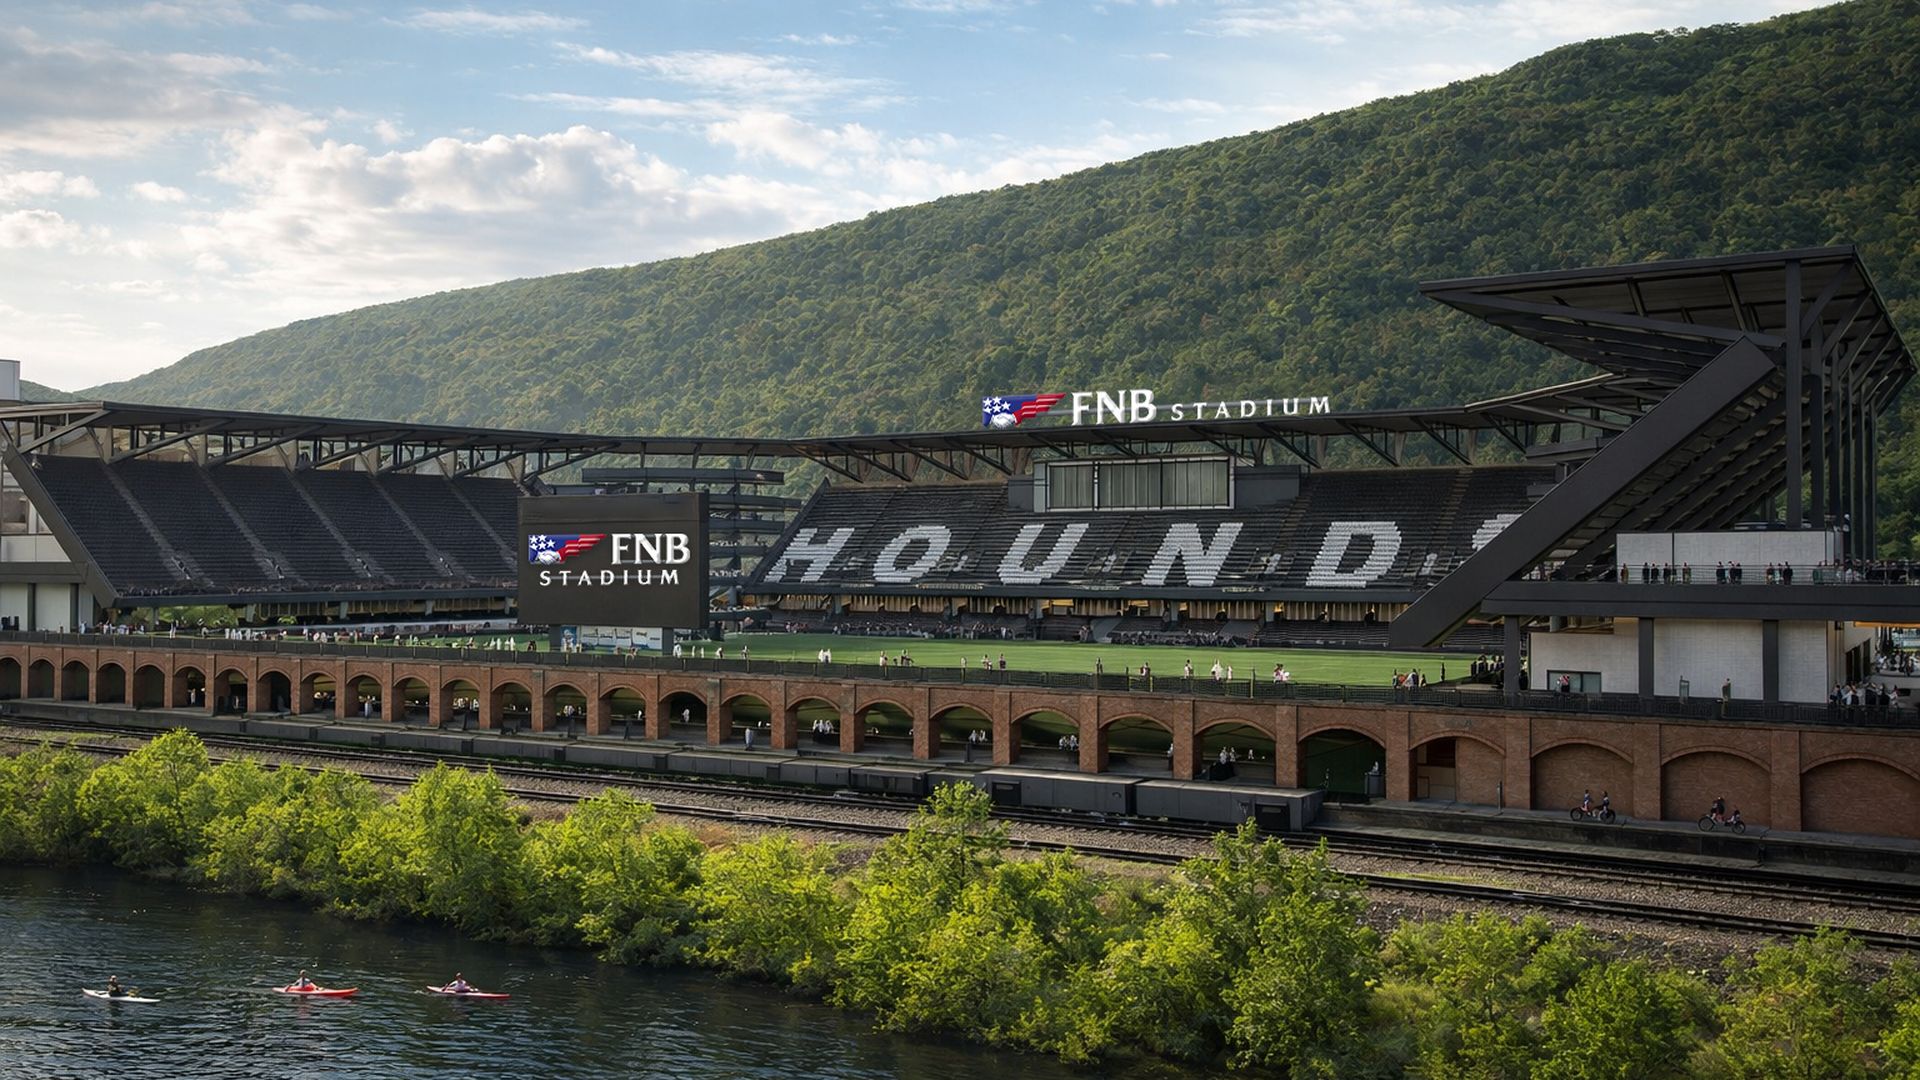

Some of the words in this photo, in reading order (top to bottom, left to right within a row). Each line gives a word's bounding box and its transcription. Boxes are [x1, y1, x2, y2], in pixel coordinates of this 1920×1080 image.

[1071, 389, 1157, 426] FNB
[1170, 396, 1331, 421] STADIUM
[611, 533, 691, 565] FNB
[763, 514, 1524, 588] HOUND
[539, 569, 679, 587] STADIUM
